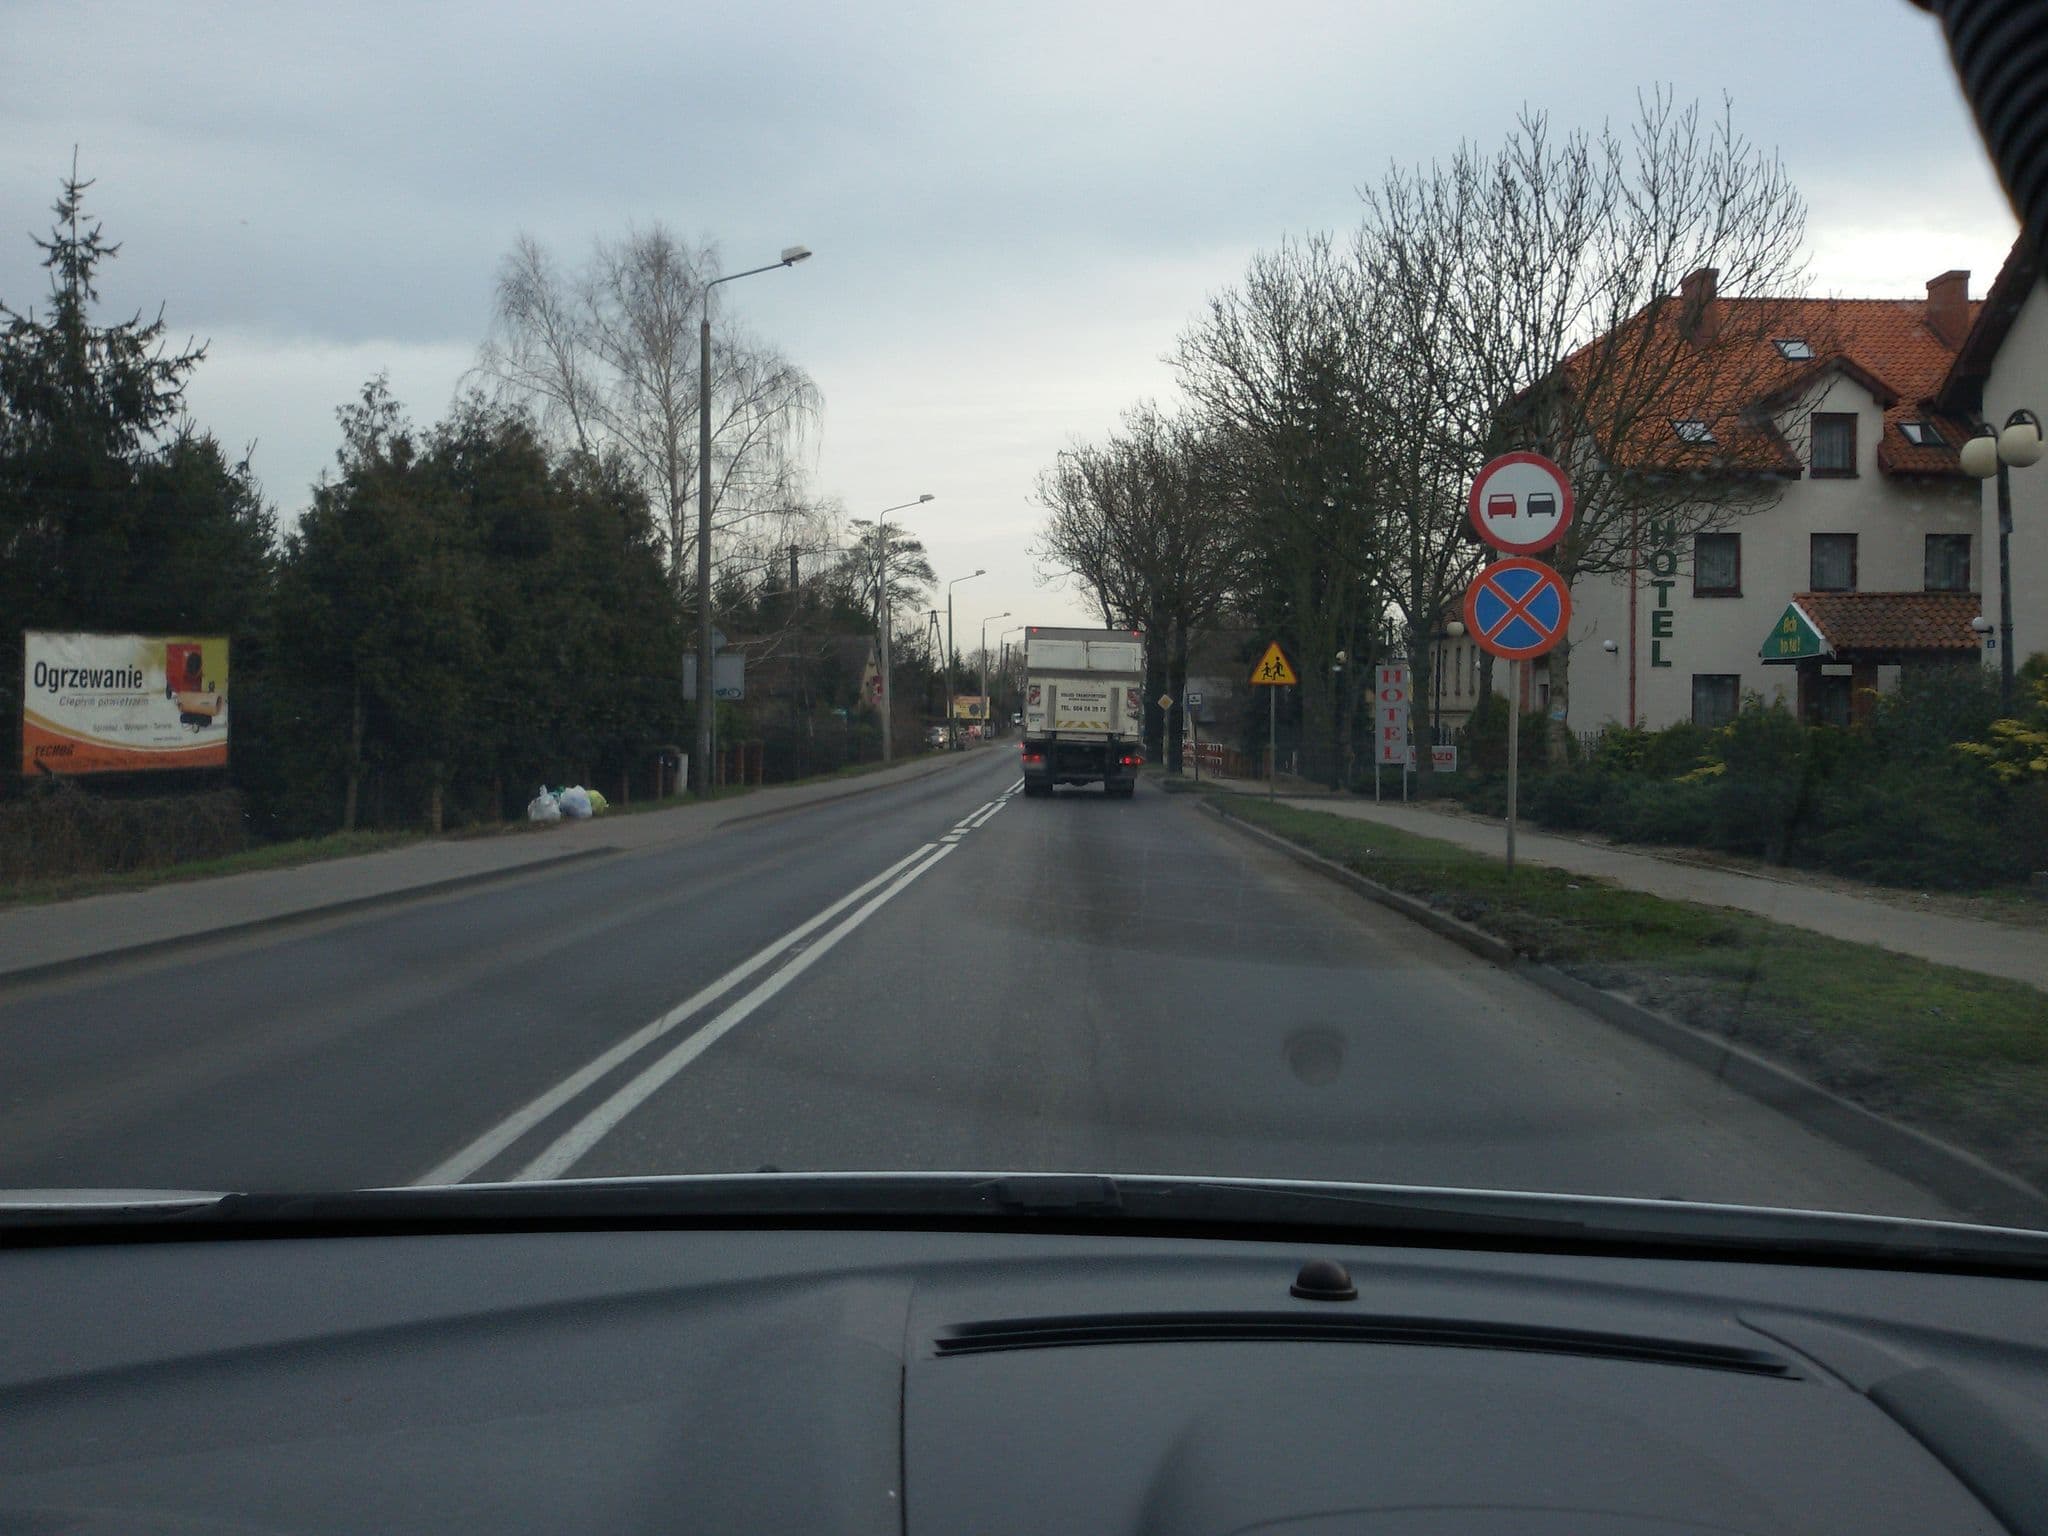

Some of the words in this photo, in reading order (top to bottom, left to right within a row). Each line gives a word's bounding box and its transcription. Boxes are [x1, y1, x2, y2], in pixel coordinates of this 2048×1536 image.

[1648, 519, 1678, 668] HOTEL
[34, 661, 143, 693] Ogrzewanie
[1380, 669, 1405, 760] HOTEL
